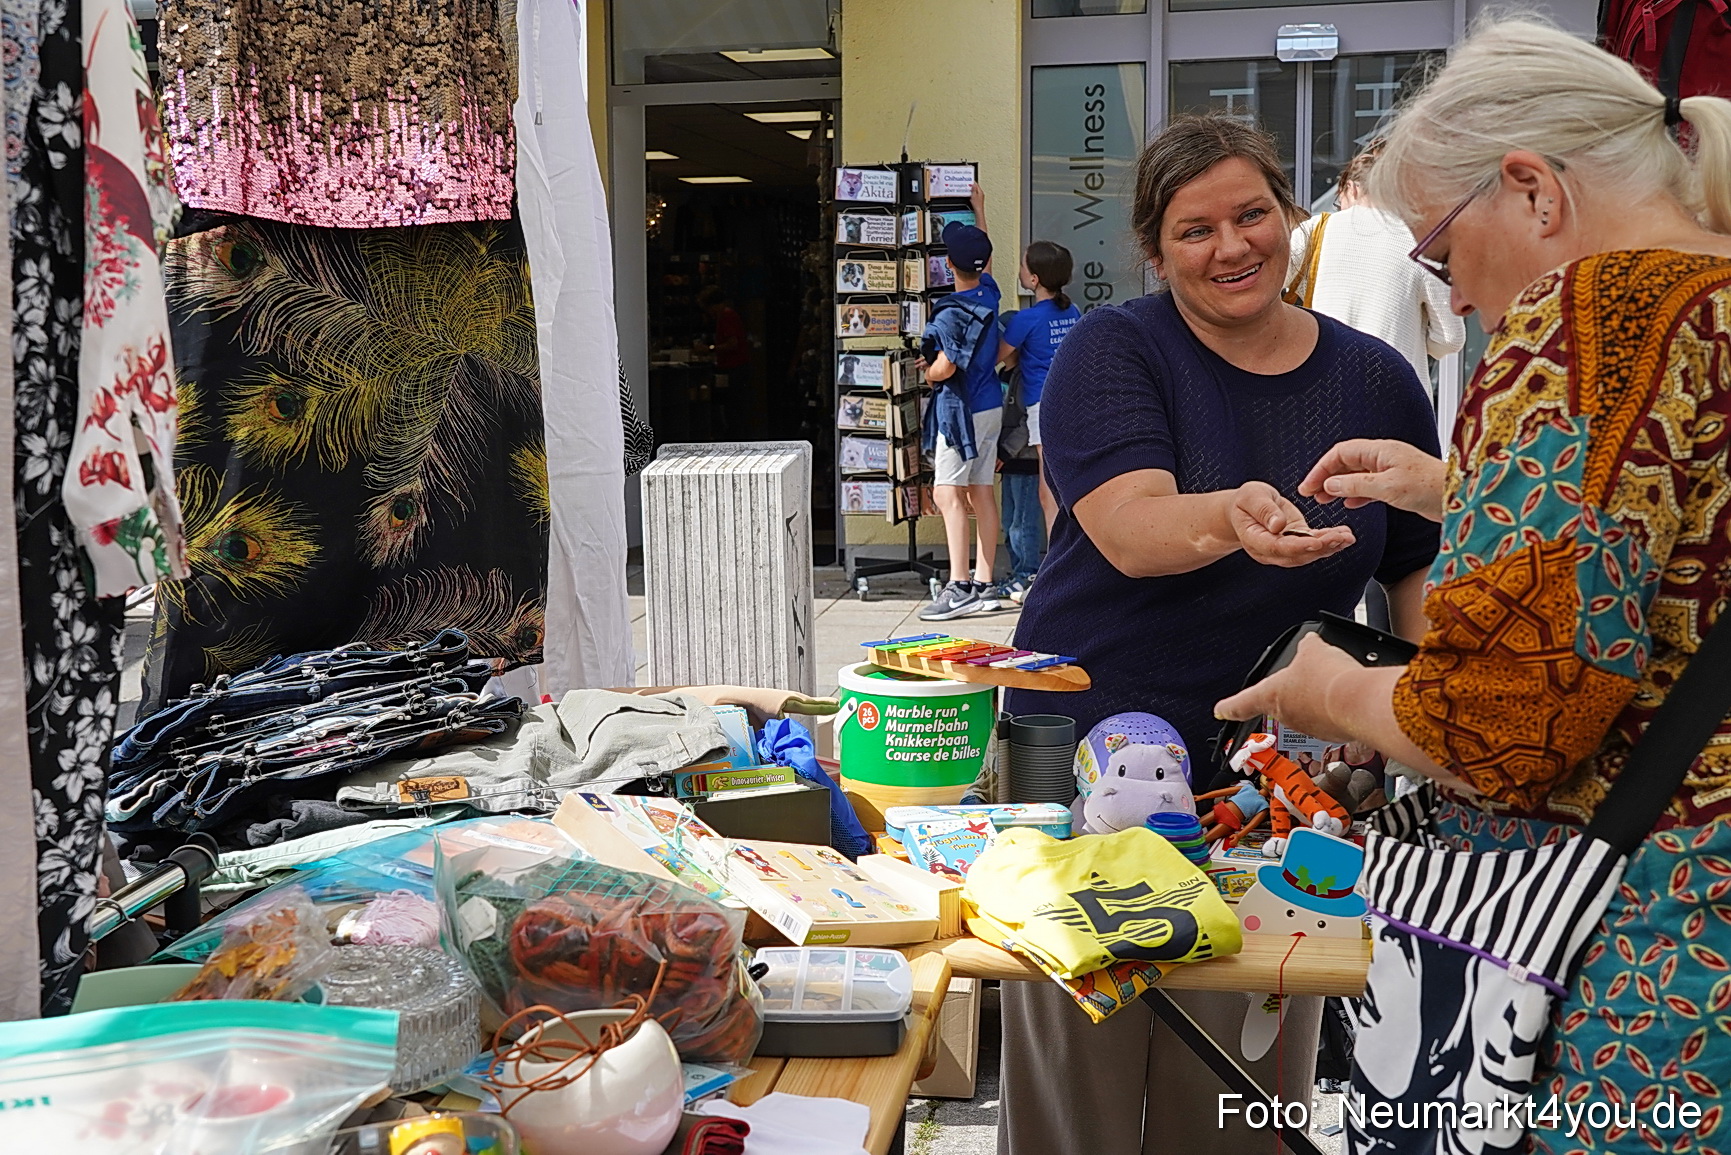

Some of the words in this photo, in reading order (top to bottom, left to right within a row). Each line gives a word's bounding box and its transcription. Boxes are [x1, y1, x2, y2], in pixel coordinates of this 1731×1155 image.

[1069, 83, 1105, 230] Wellness
[860, 186, 894, 198] Akita
[866, 234, 894, 242] Terrier
[871, 318, 897, 326] Beagle
[862, 707, 873, 716] 26
[884, 703, 934, 719] Marble
[935, 706, 958, 718] run
[862, 716, 876, 725] pcs
[884, 718, 969, 733] Murmelbahn
[884, 733, 969, 748] Knikkerbaan
[885, 748, 931, 762] Course
[932, 748, 950, 762] de
[951, 746, 981, 761] billes
[730, 773, 786, 787] Dinosaurier-Wissen
[950, 842, 976, 851] Tiere
[1178, 876, 1200, 888] BIN
[1067, 881, 1200, 961] 5
[810, 932, 847, 941] Zahlen-Puzzle
